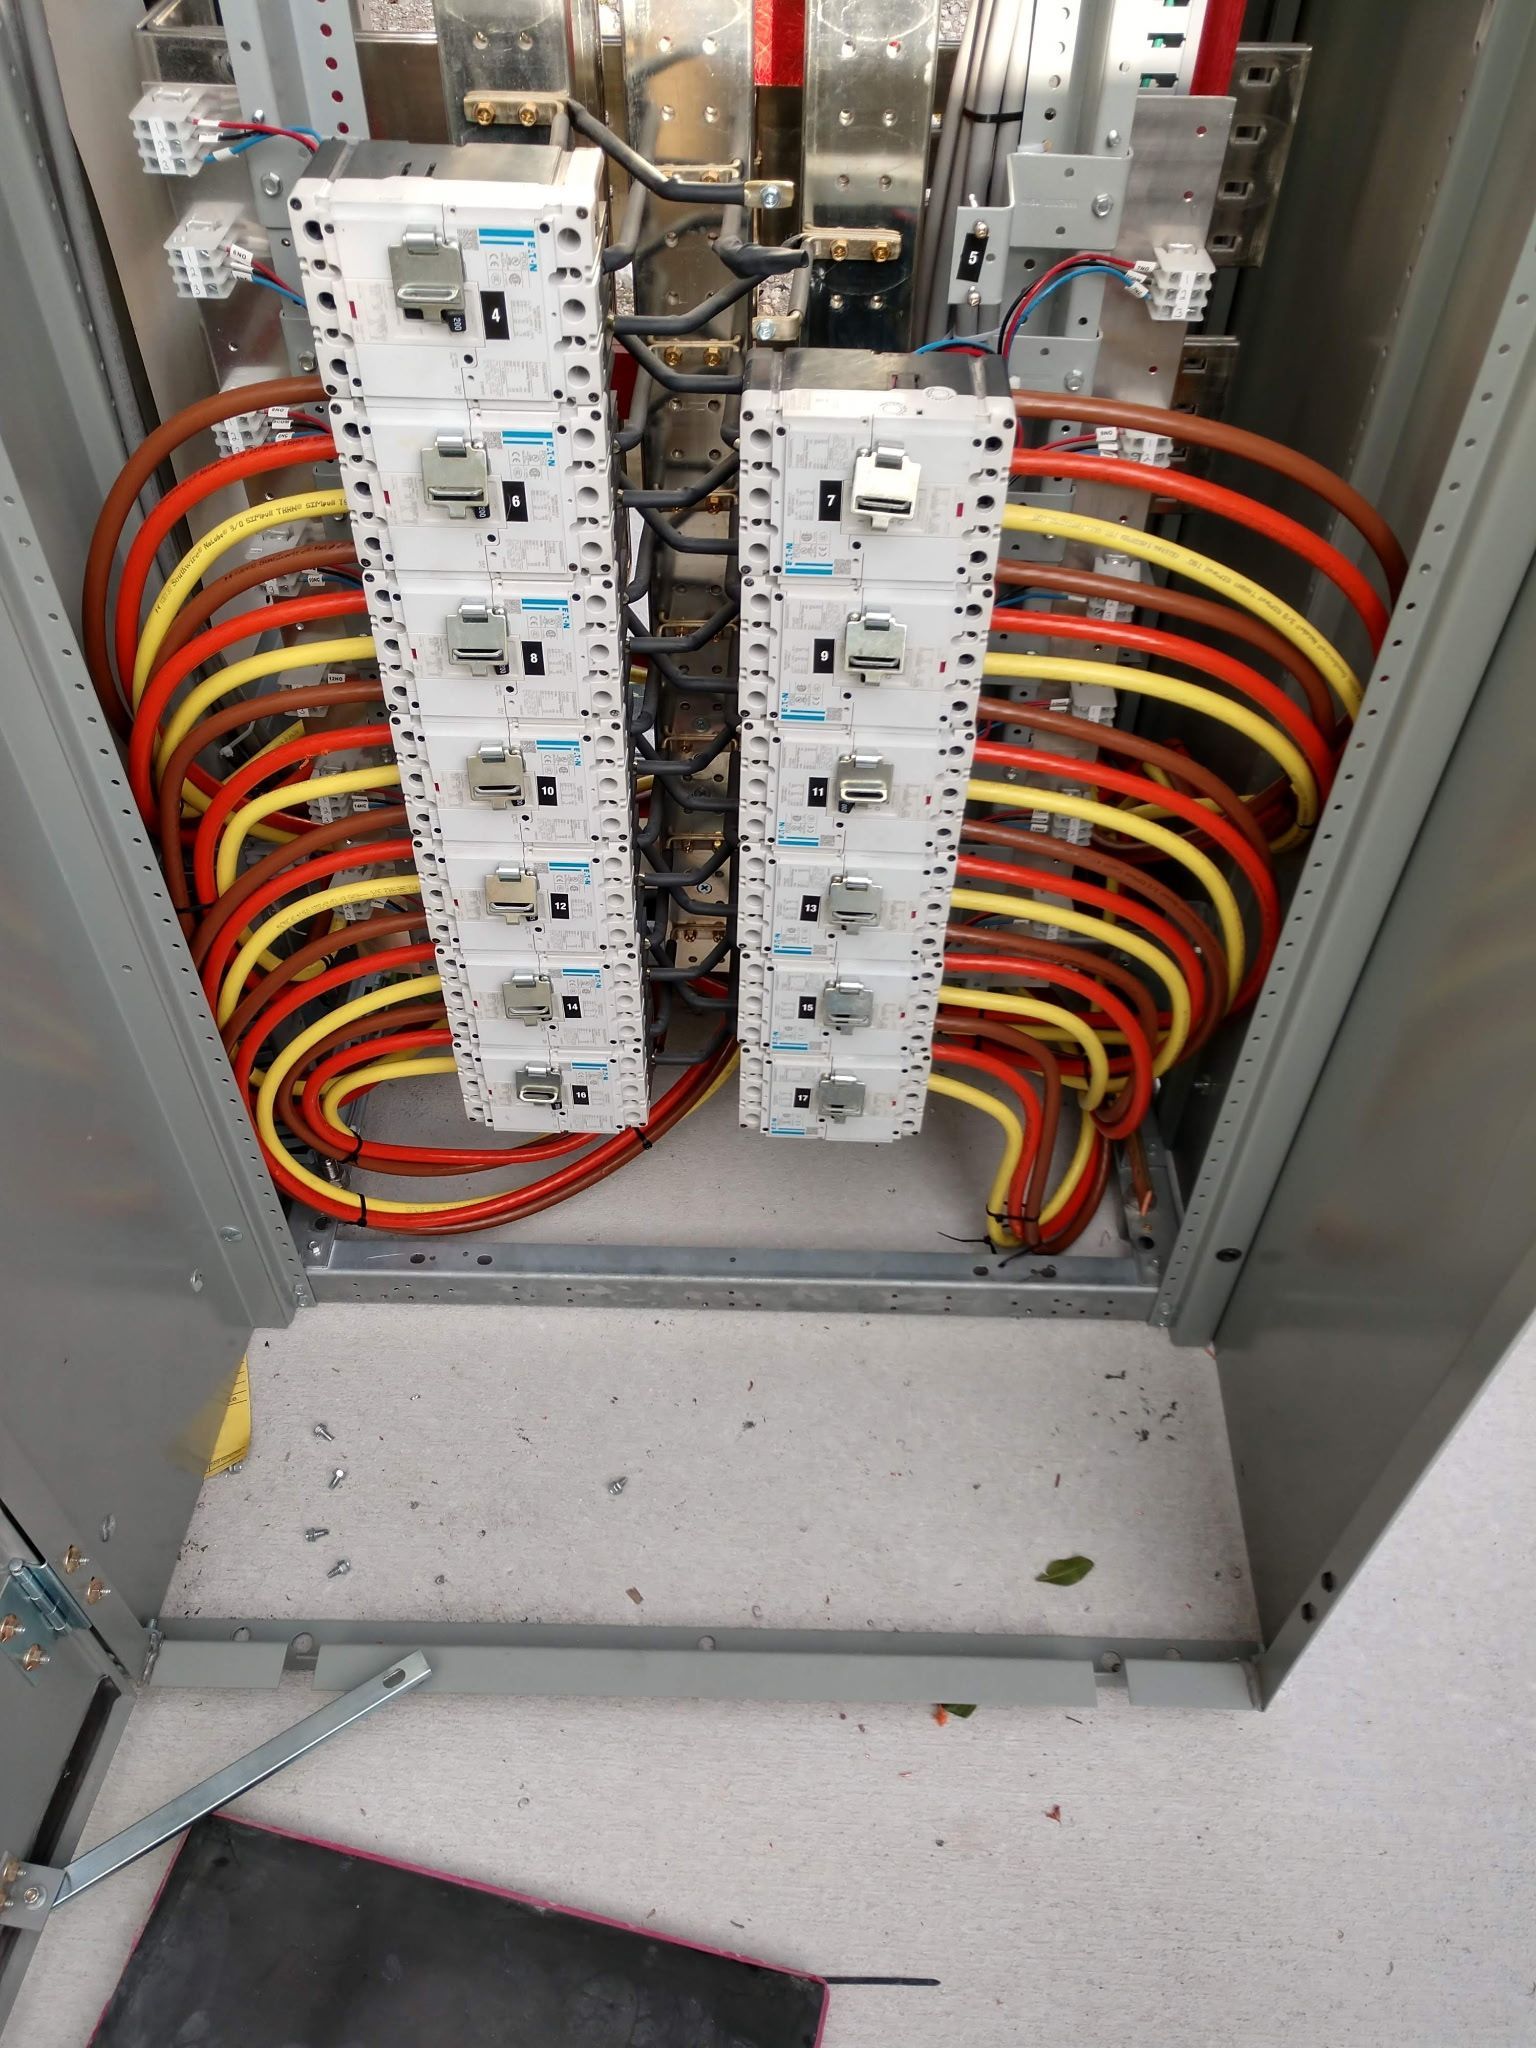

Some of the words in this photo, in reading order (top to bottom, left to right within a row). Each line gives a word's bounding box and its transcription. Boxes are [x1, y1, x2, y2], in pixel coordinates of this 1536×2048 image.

[968, 250, 980, 265] 5
[491, 307, 501, 323] 4
[453, 317, 462, 331] 200
[511, 494, 521, 507] 6
[826, 494, 836, 507] 7
[530, 652, 538, 663] 8
[820, 650, 829, 662] 9
[541, 786, 555, 796] 10
[812, 787, 824, 797] 11
[554, 902, 567, 910] 12
[804, 904, 818, 913] 13
[566, 1003, 579, 1011] 14
[802, 1003, 814, 1012] 15
[575, 1091, 587, 1099] 16
[797, 1094, 809, 1102] 17
